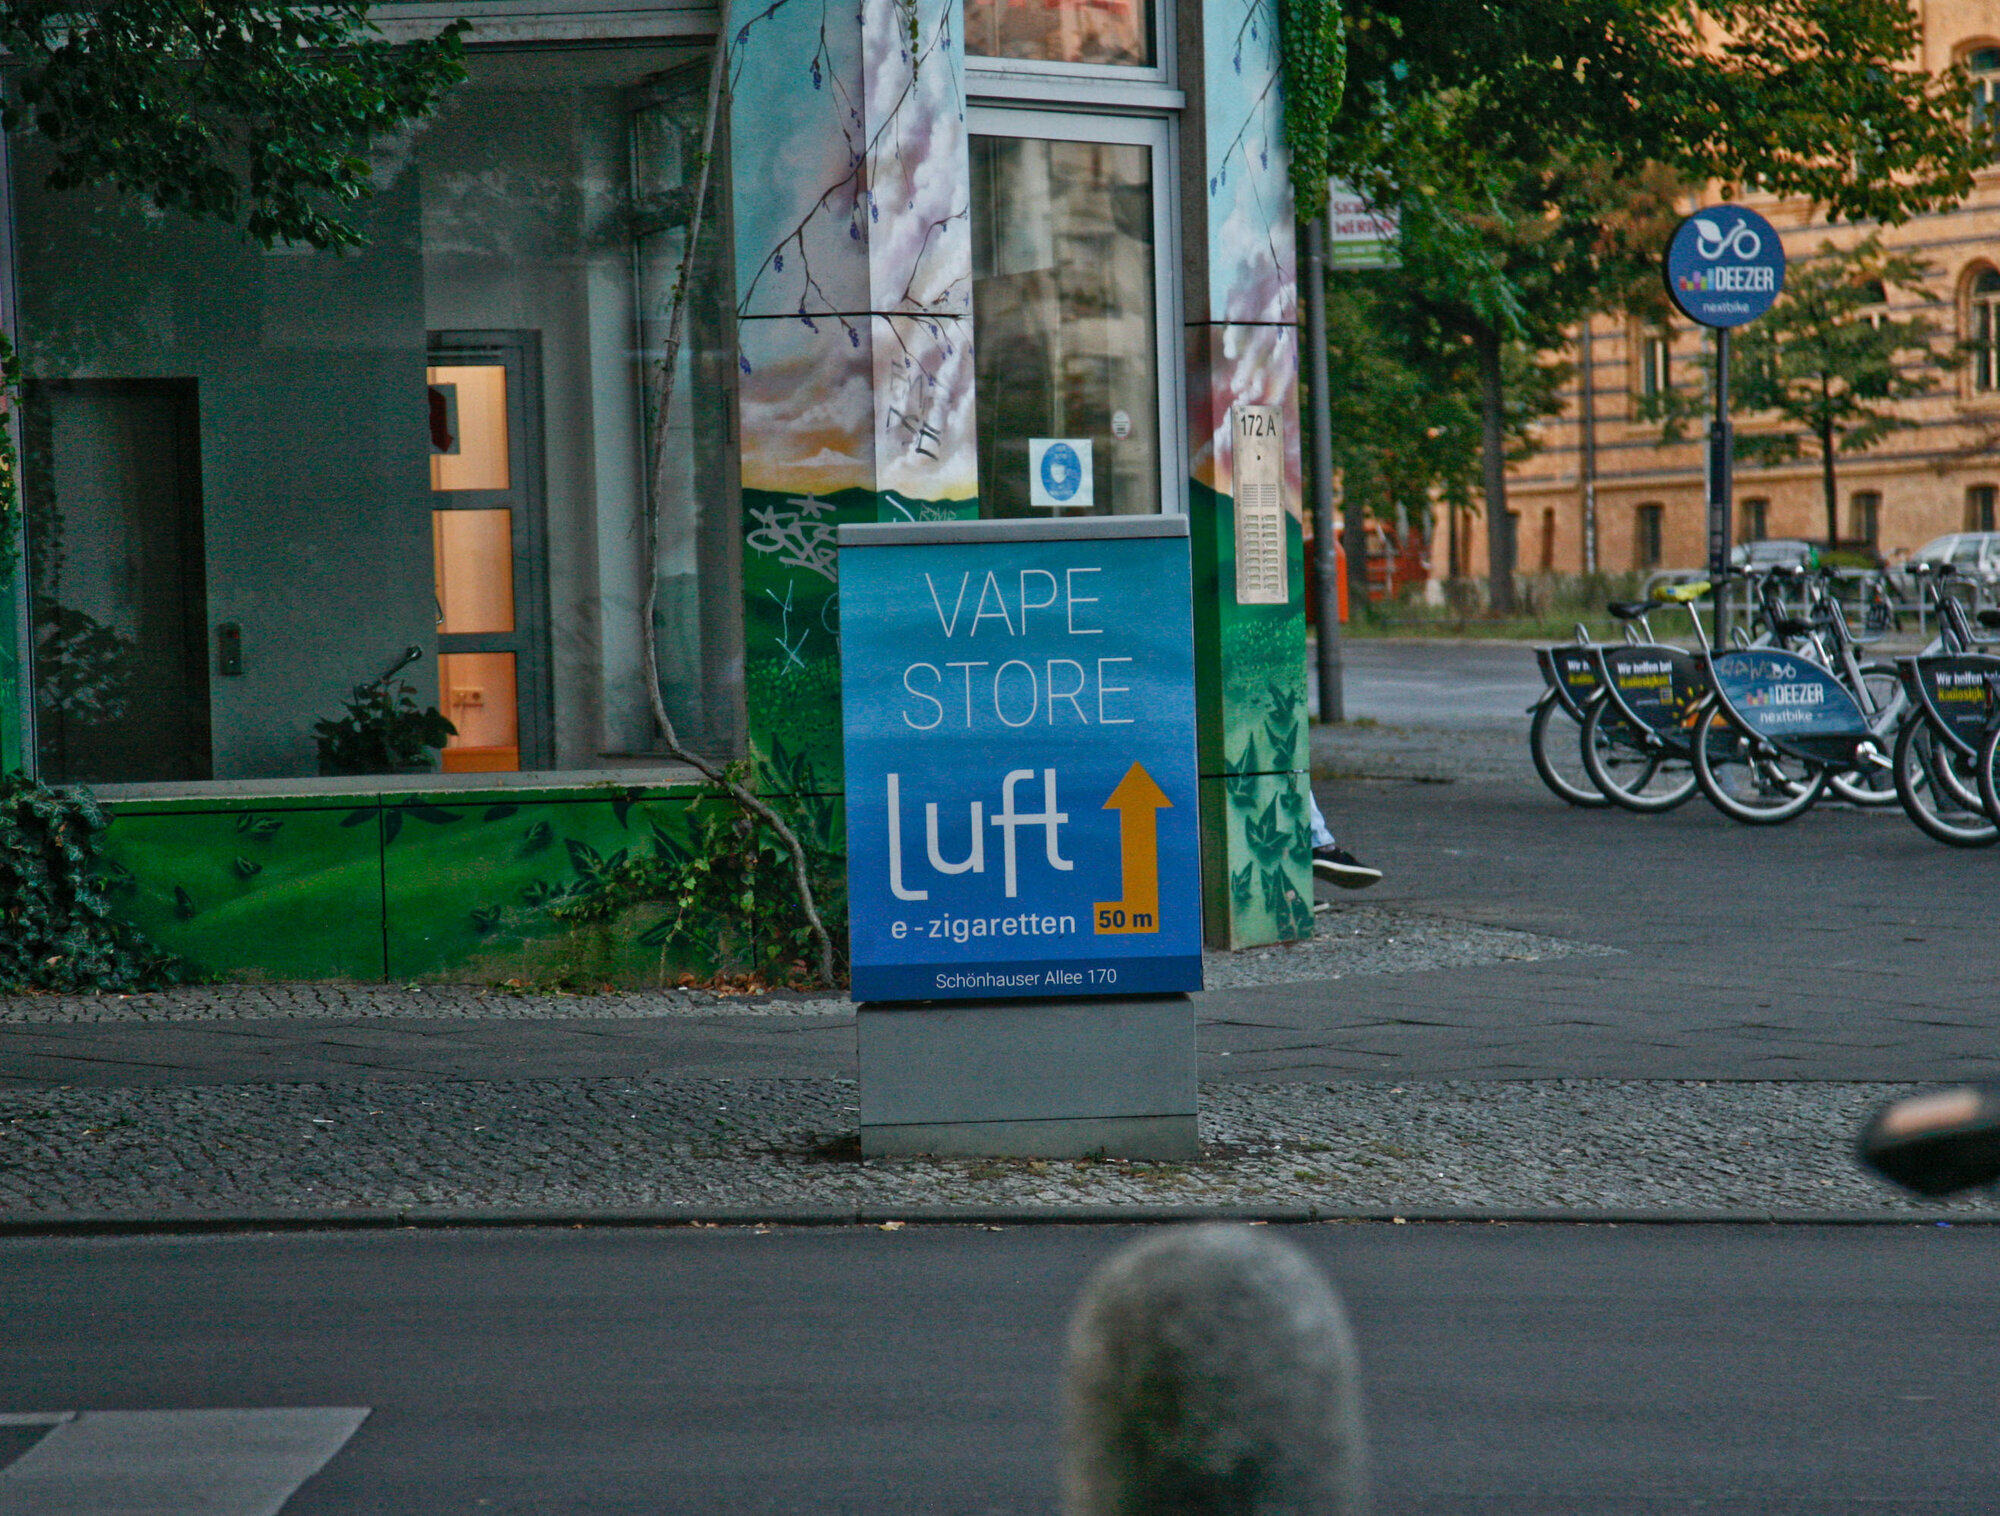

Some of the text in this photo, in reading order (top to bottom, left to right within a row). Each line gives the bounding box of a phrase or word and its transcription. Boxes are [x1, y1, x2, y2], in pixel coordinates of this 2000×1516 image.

[1715, 266, 1774, 292] DEEZER
[1703, 300, 1750, 314] nextbike
[1240, 415, 1277, 437] 172 A
[925, 567, 1104, 638] VAPE
[1617, 661, 1632, 674] Wir
[1935, 671, 1951, 686] Wir
[1953, 670, 1983, 686] helfen
[902, 656, 1136, 730] STORE
[1775, 682, 1824, 705] DEEZER
[1760, 708, 1814, 724] nextbike
[886, 767, 1074, 902] luft
[1098, 909, 1154, 930] 50 m
[935, 968, 1118, 989] Schönhauser Allee 170
